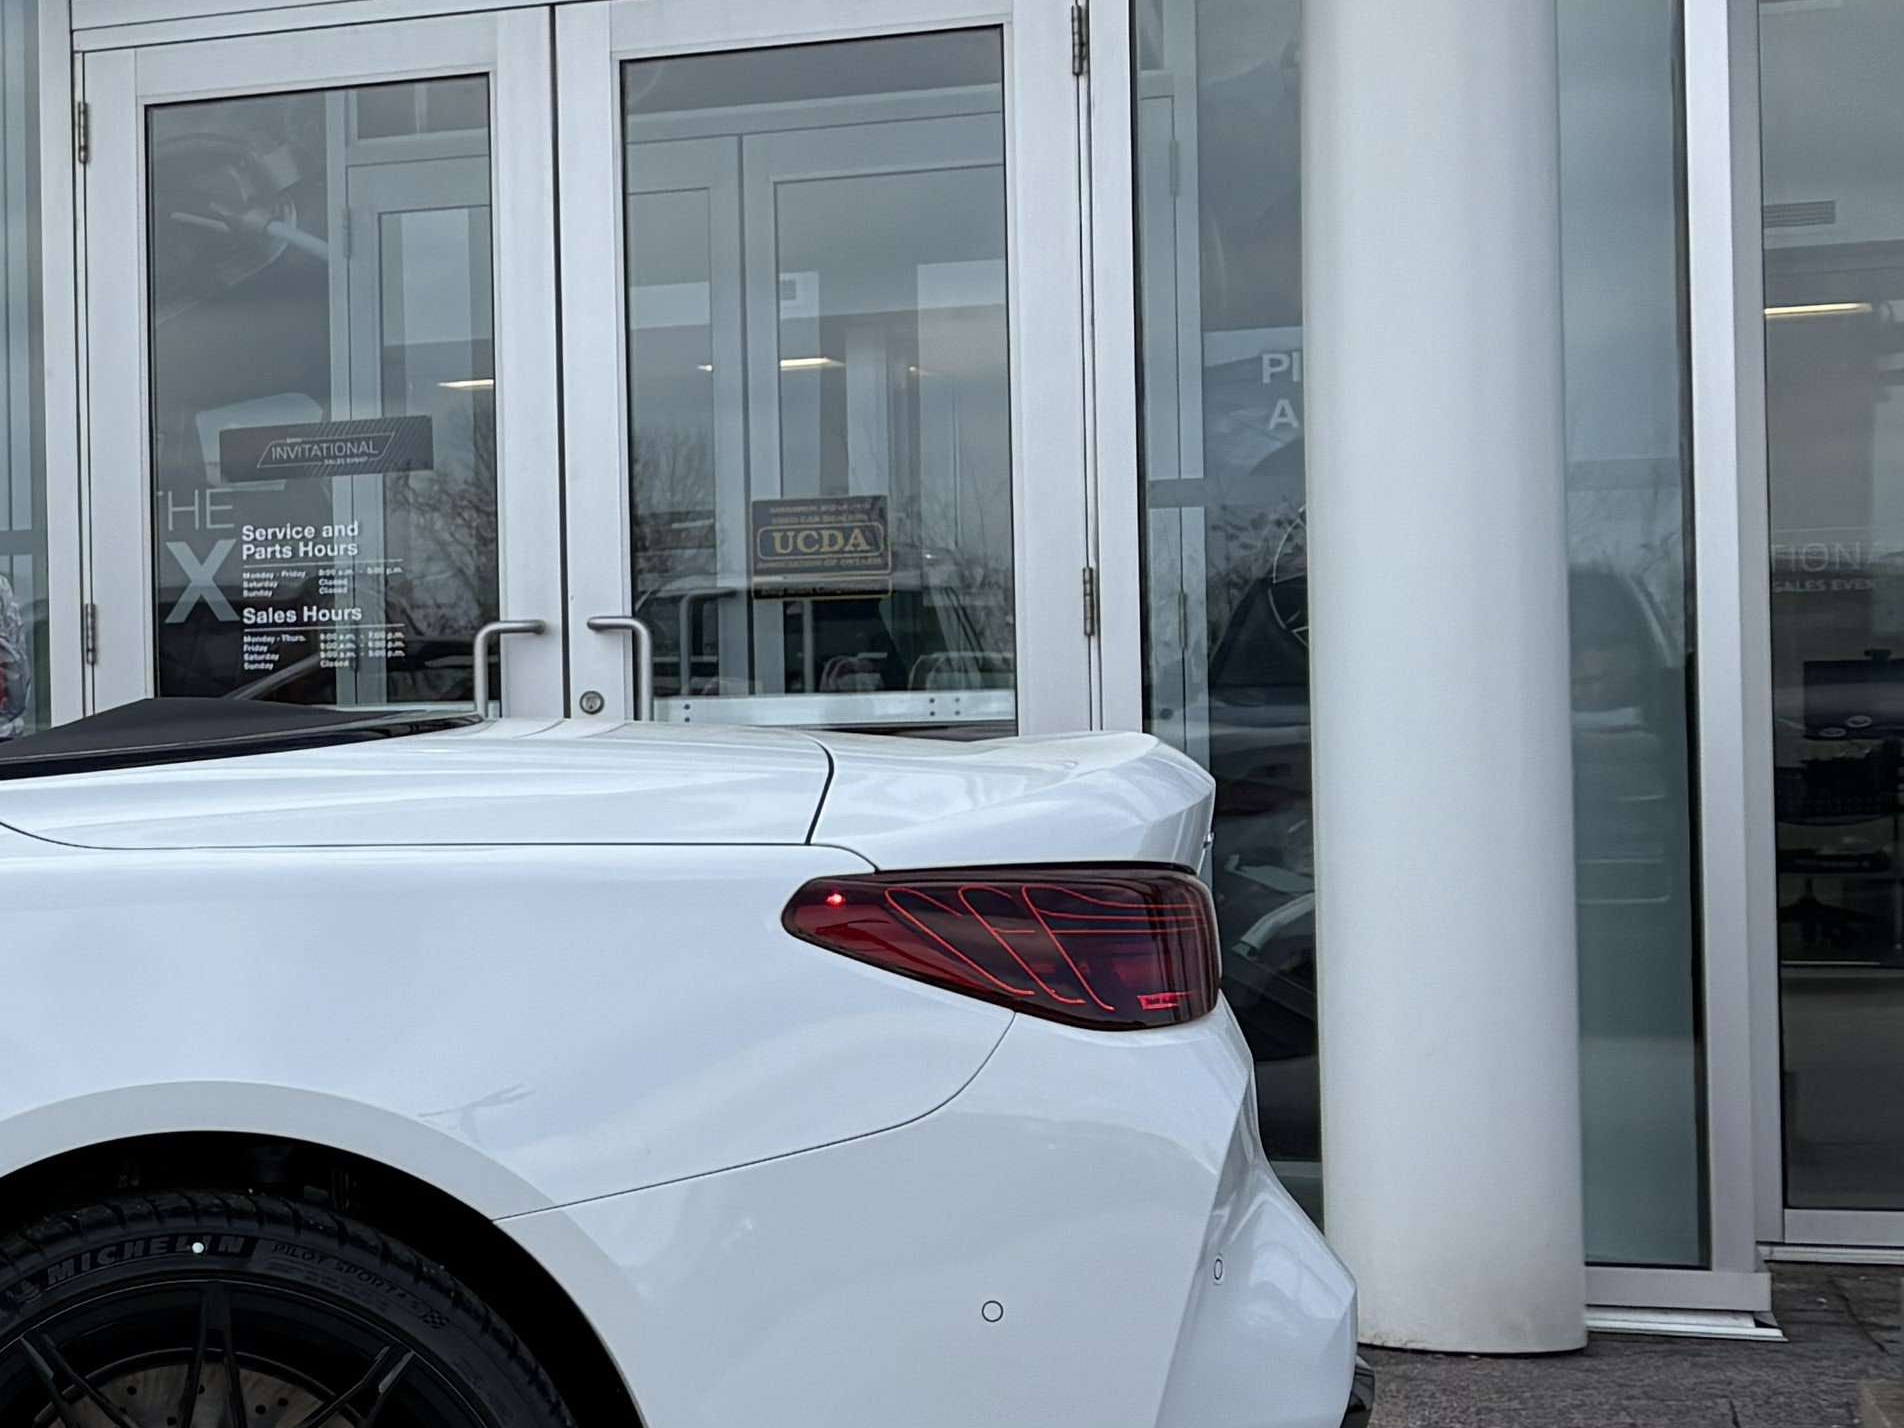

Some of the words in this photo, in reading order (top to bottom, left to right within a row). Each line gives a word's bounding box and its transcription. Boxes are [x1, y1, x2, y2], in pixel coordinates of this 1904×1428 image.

[272, 439, 379, 460] INVITATIONAL
[158, 489, 235, 531] HE
[242, 523, 315, 541] Service
[321, 521, 359, 538] and
[242, 541, 293, 561] Parts
[298, 540, 359, 558] Hours
[772, 528, 873, 554] UCDA
[164, 538, 240, 623] X
[242, 580, 279, 589] Saturday
[319, 578, 348, 586] Closed
[281, 570, 306, 579] Friday
[242, 589, 273, 598] Sunday
[319, 586, 348, 594] Closed
[243, 607, 297, 624] Sales
[303, 605, 362, 623] Hours
[243, 643, 268, 653] Friday
[243, 652, 280, 661] Saturday
[243, 661, 274, 670] Sunday
